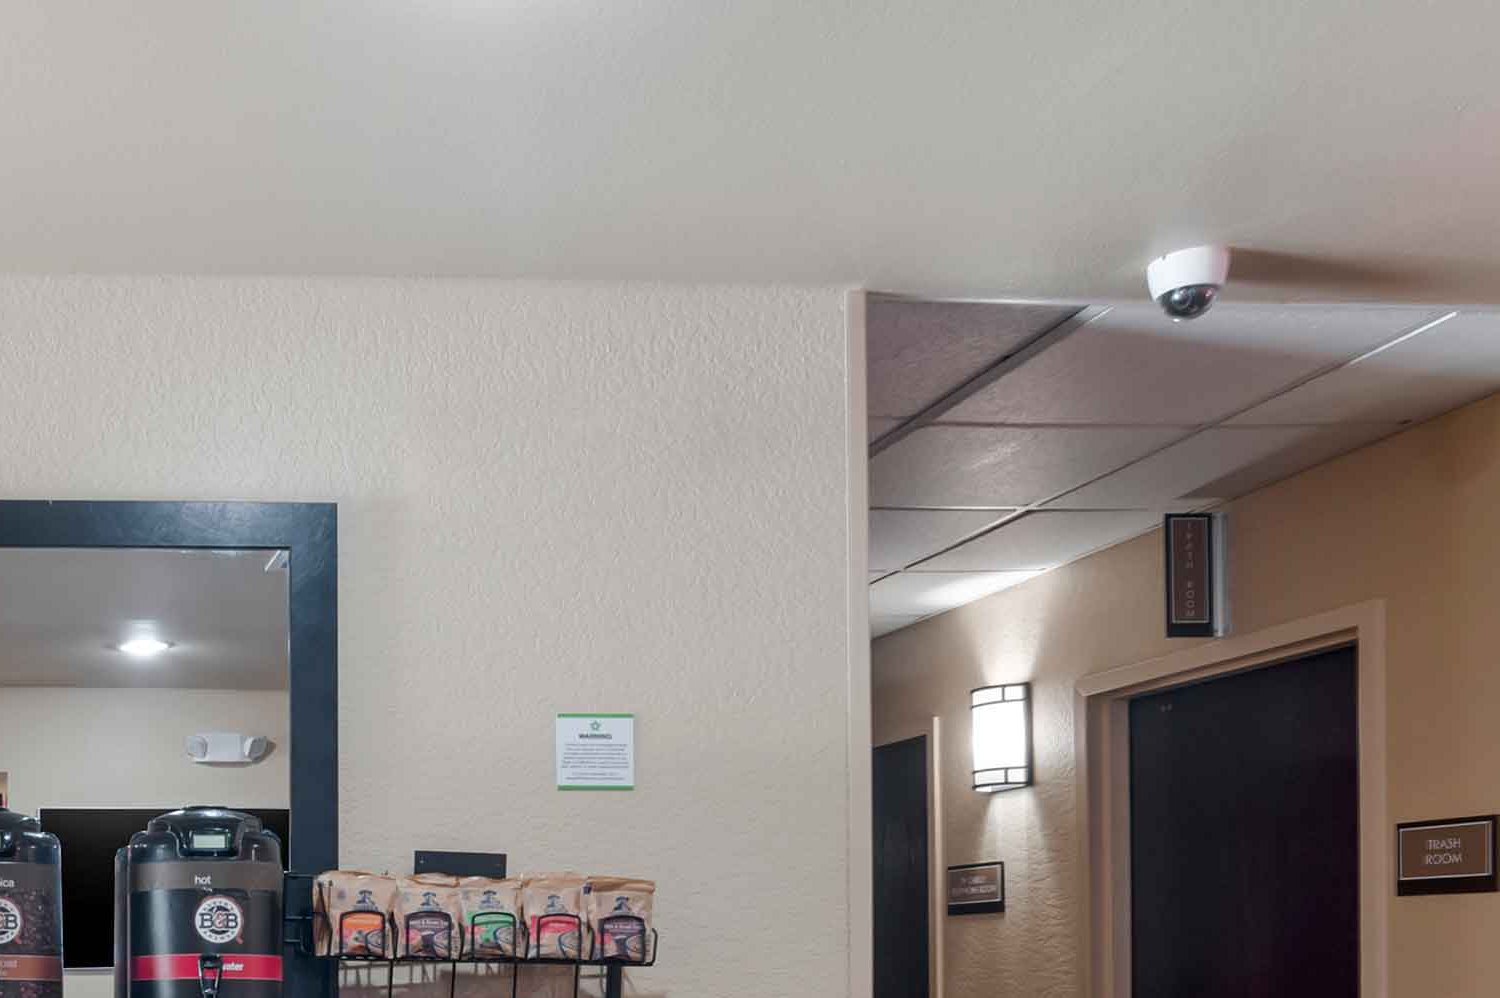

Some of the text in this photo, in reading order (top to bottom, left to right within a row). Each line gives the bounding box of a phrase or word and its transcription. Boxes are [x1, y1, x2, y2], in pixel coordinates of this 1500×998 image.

[1427, 837, 1462, 850] TRASH
[1425, 852, 1464, 866] ROOM
[194, 874, 212, 886] hot
